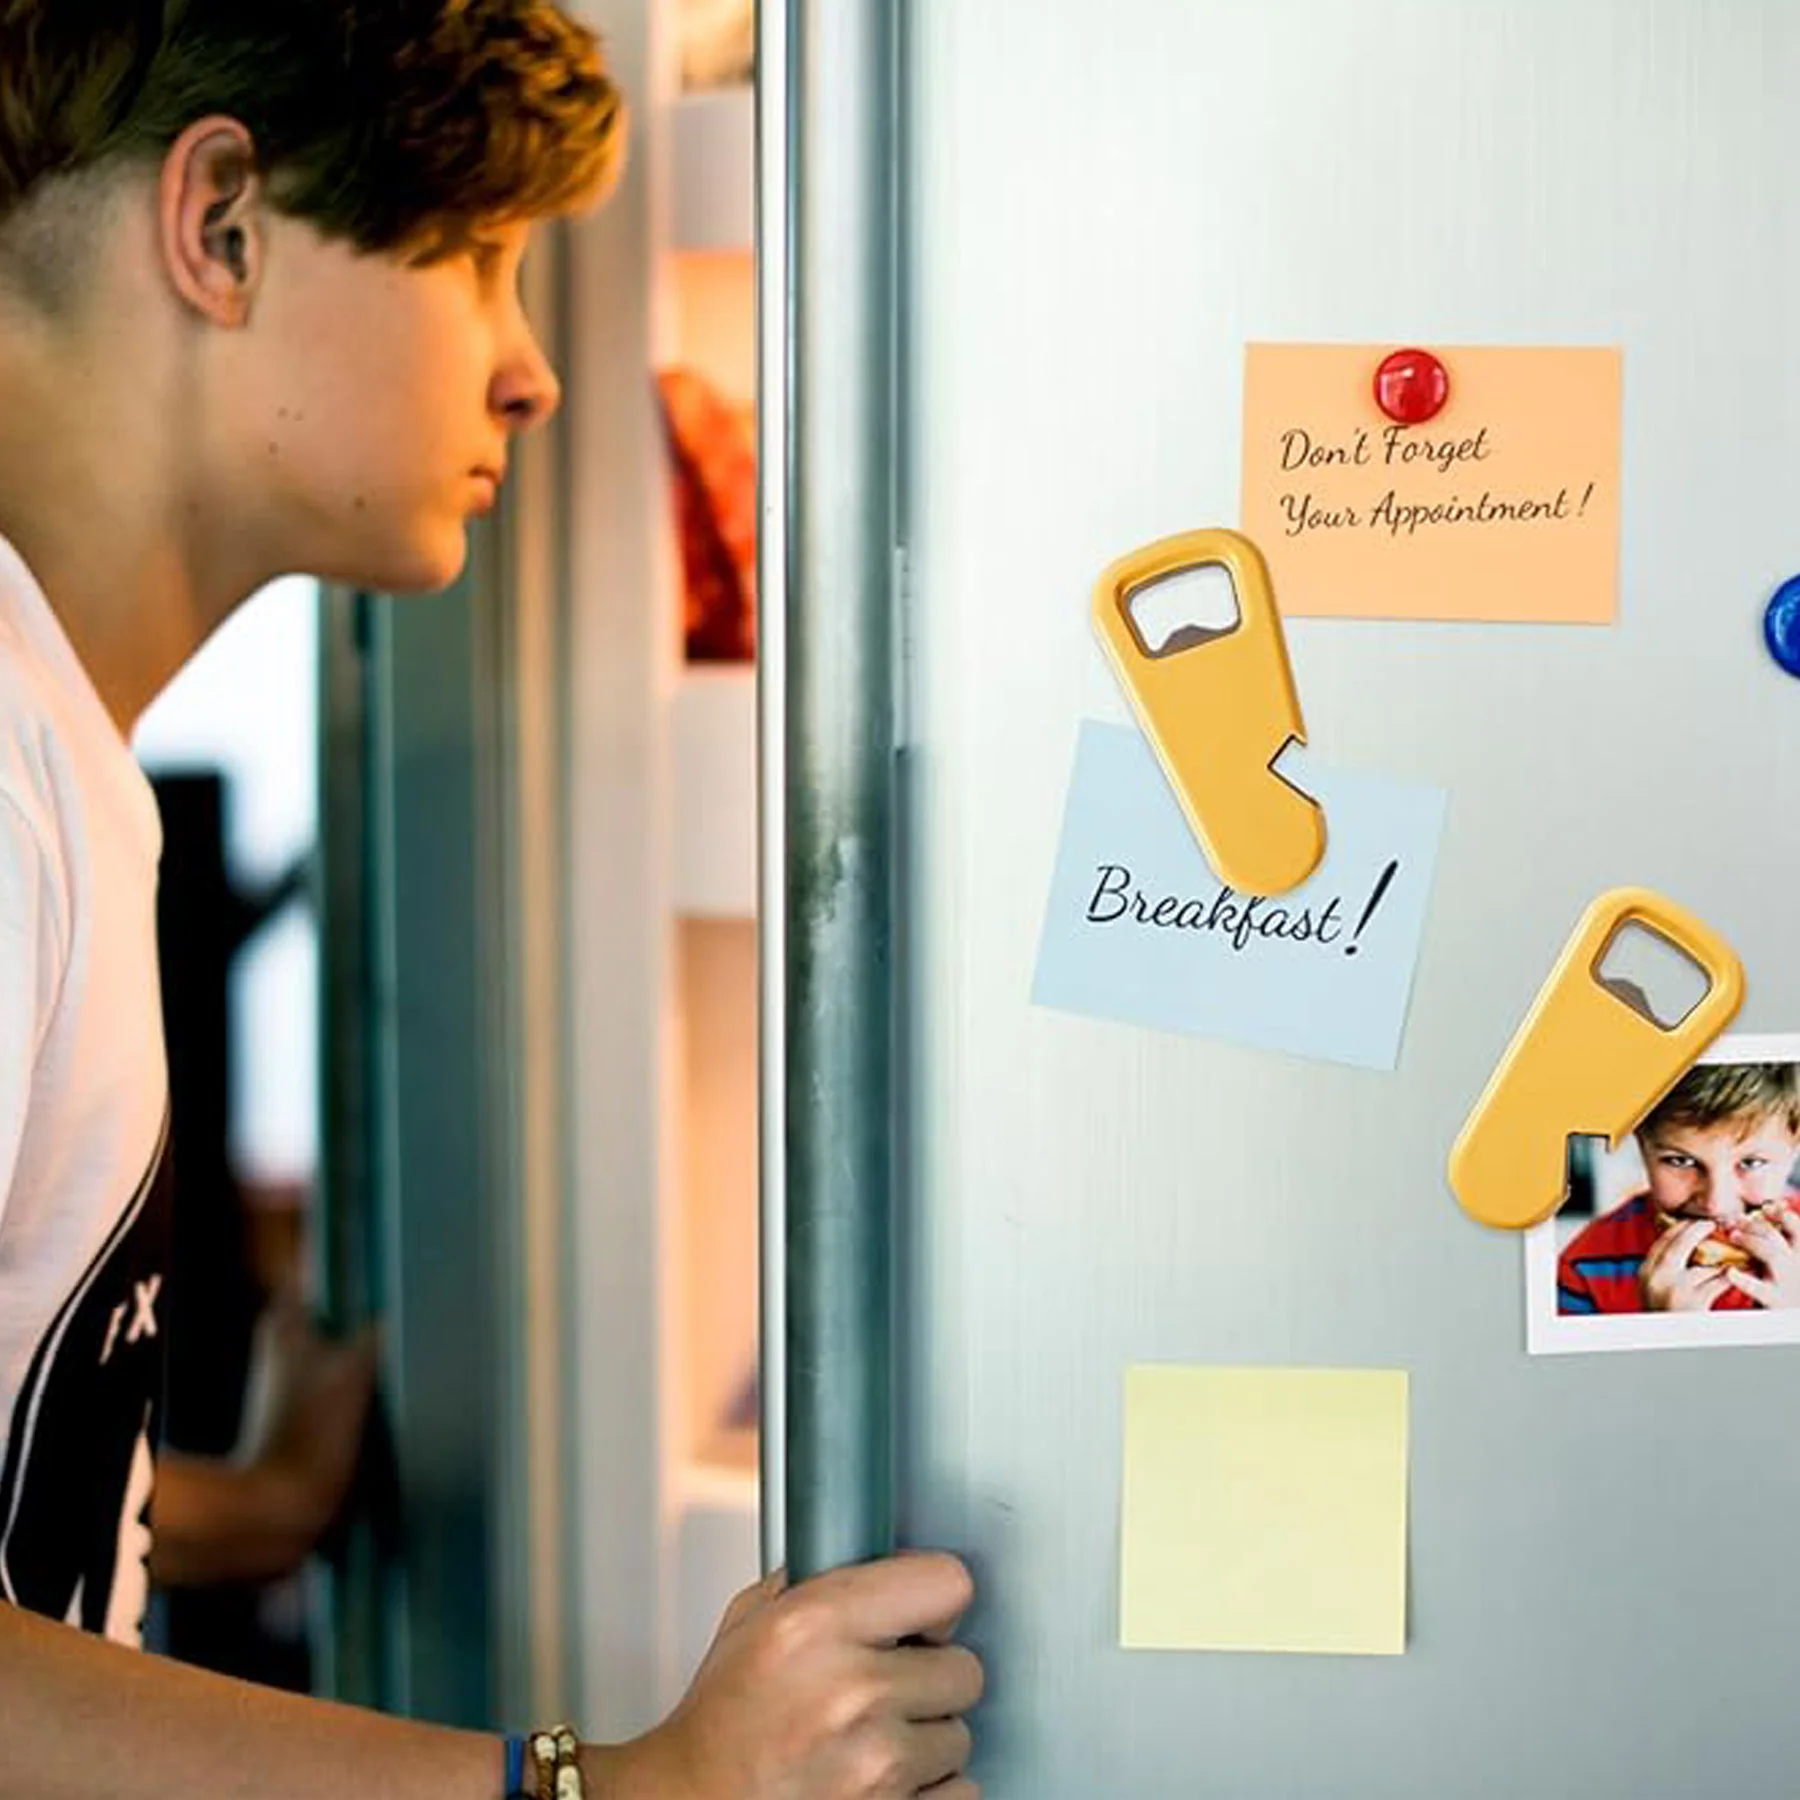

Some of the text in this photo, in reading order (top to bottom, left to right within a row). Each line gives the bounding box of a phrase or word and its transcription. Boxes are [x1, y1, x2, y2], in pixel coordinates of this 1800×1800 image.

[1280, 425, 1491, 473] Don't Forget
[1280, 493, 1361, 536] Your
